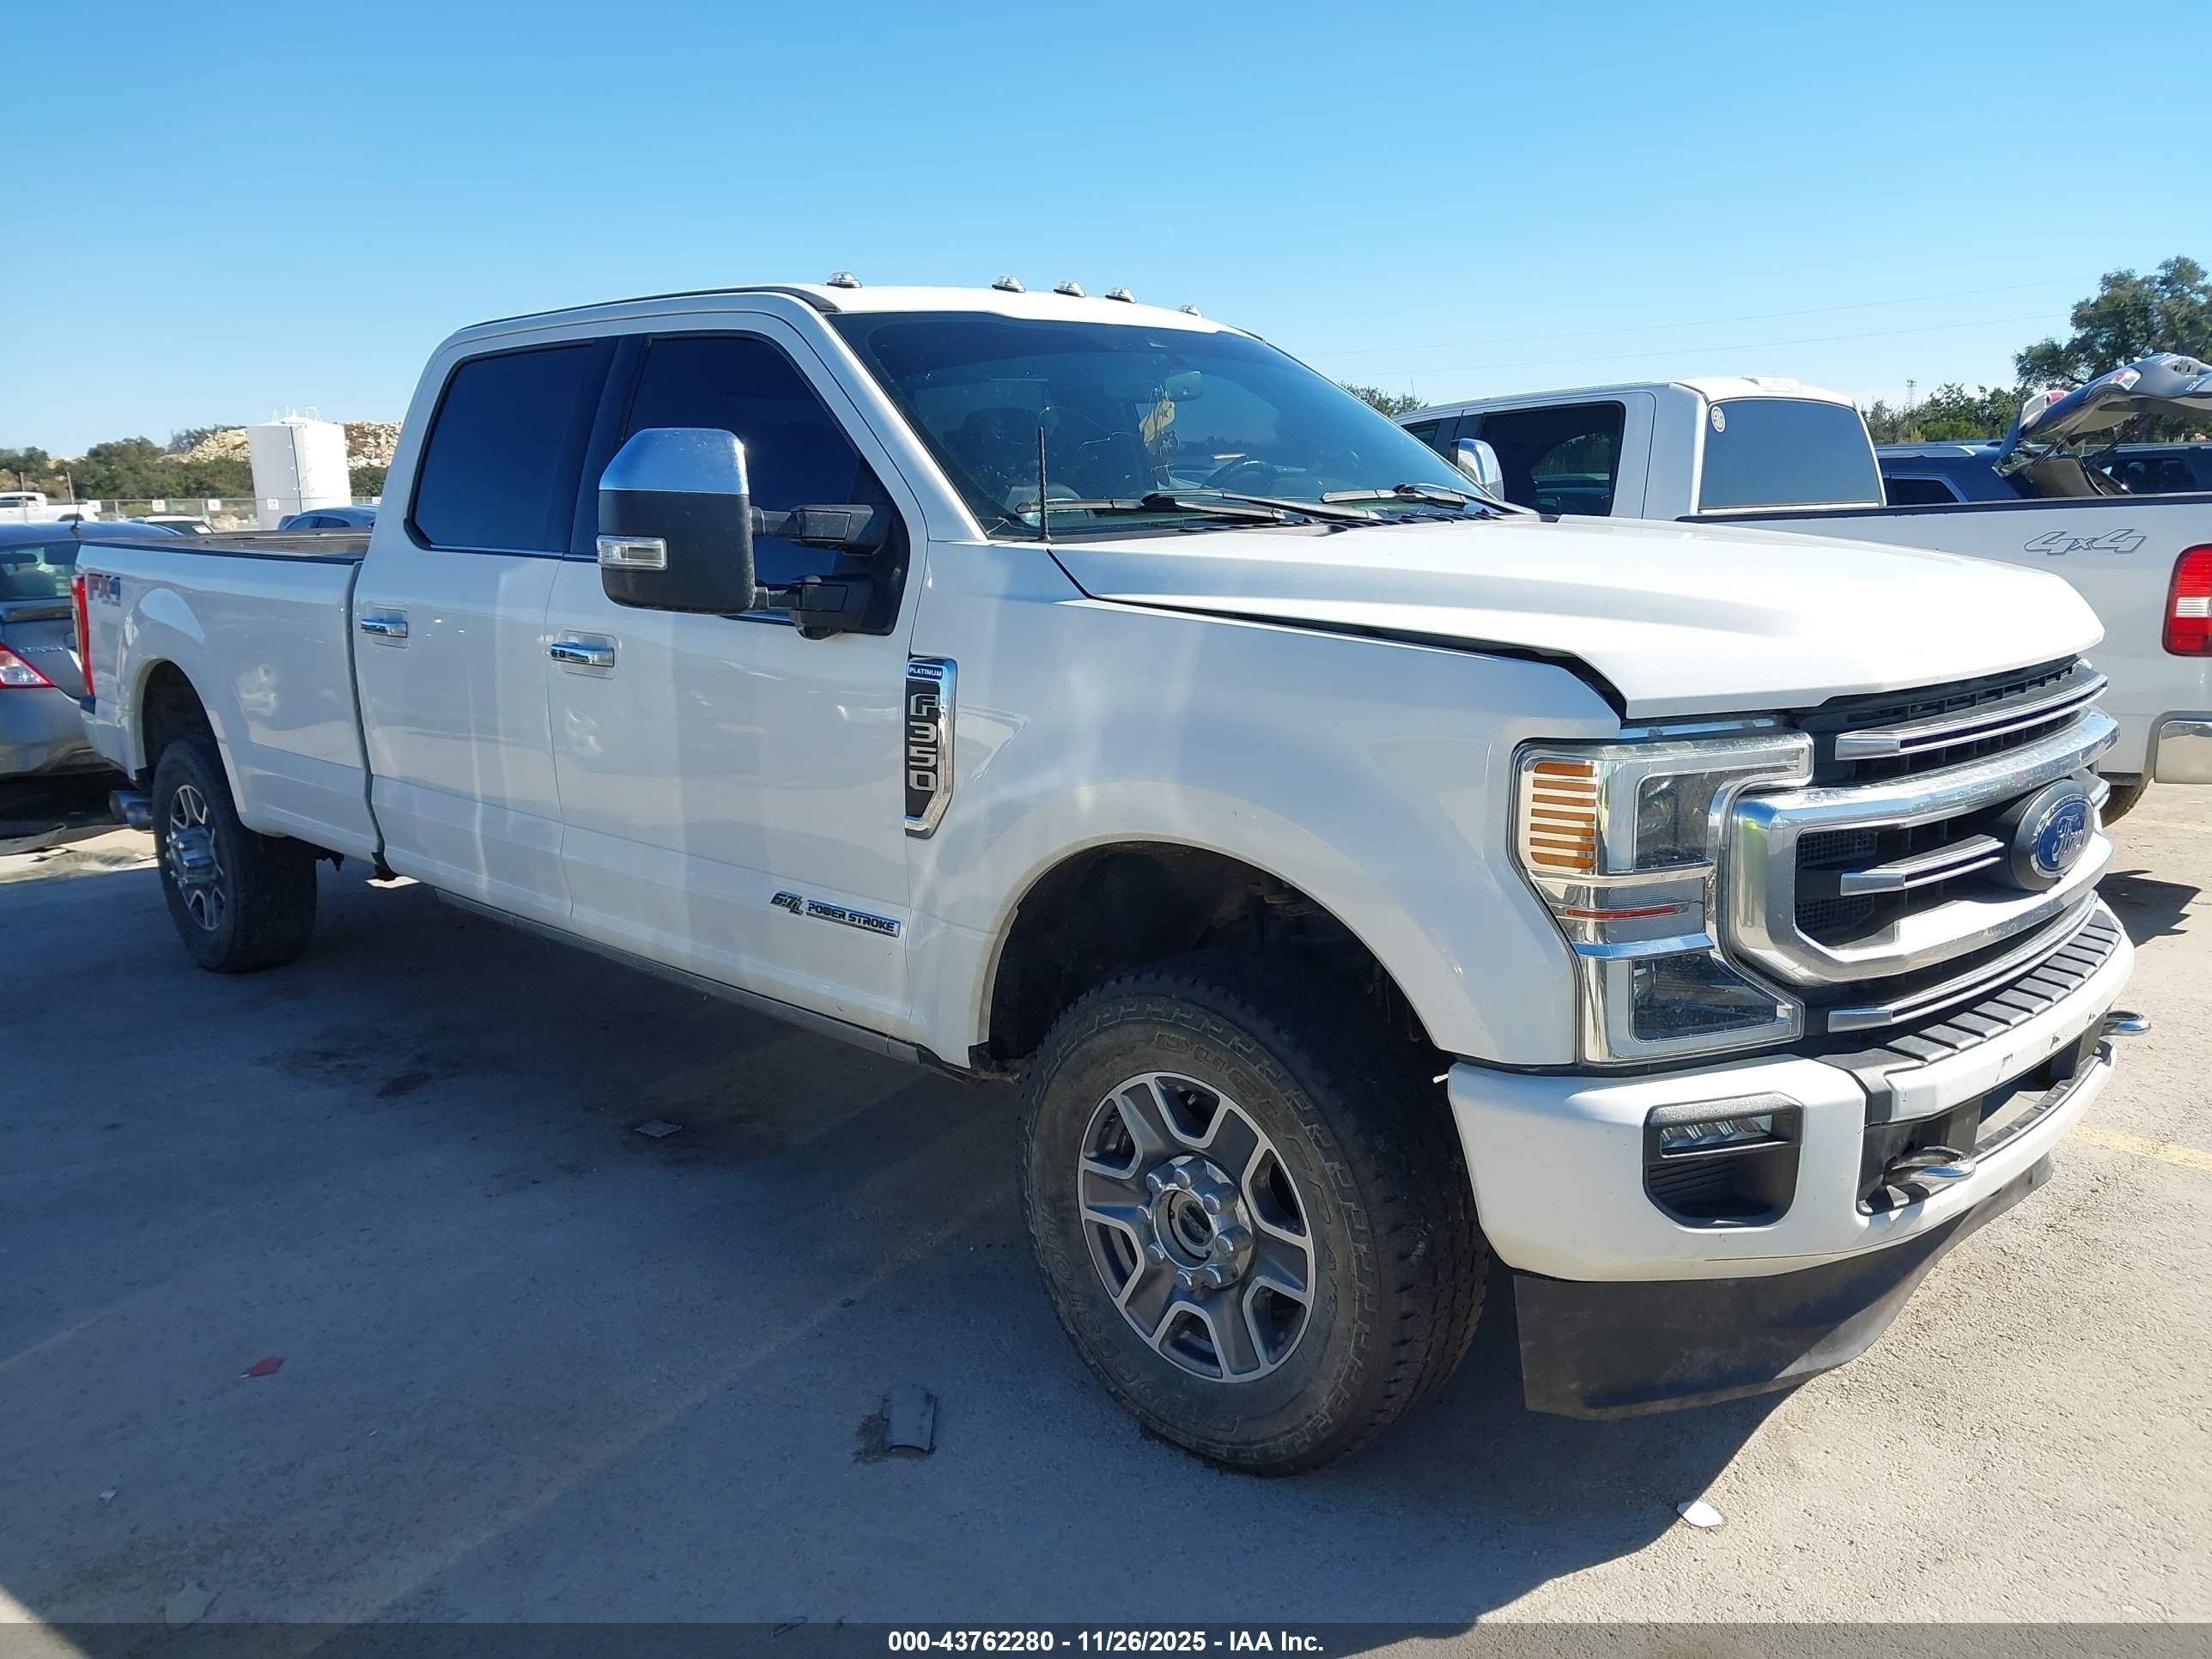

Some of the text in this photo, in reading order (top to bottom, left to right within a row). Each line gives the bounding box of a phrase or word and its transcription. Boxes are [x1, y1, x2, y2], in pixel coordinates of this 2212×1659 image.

[2024, 528, 2146, 556] 4x4
[88, 573, 121, 602] FX4
[908, 666, 942, 677] PLATINUM
[908, 693, 939, 792] F350
[2051, 812, 2087, 862] Ford
[807, 902, 846, 921] POWER
[848, 913, 895, 932] STROKE
